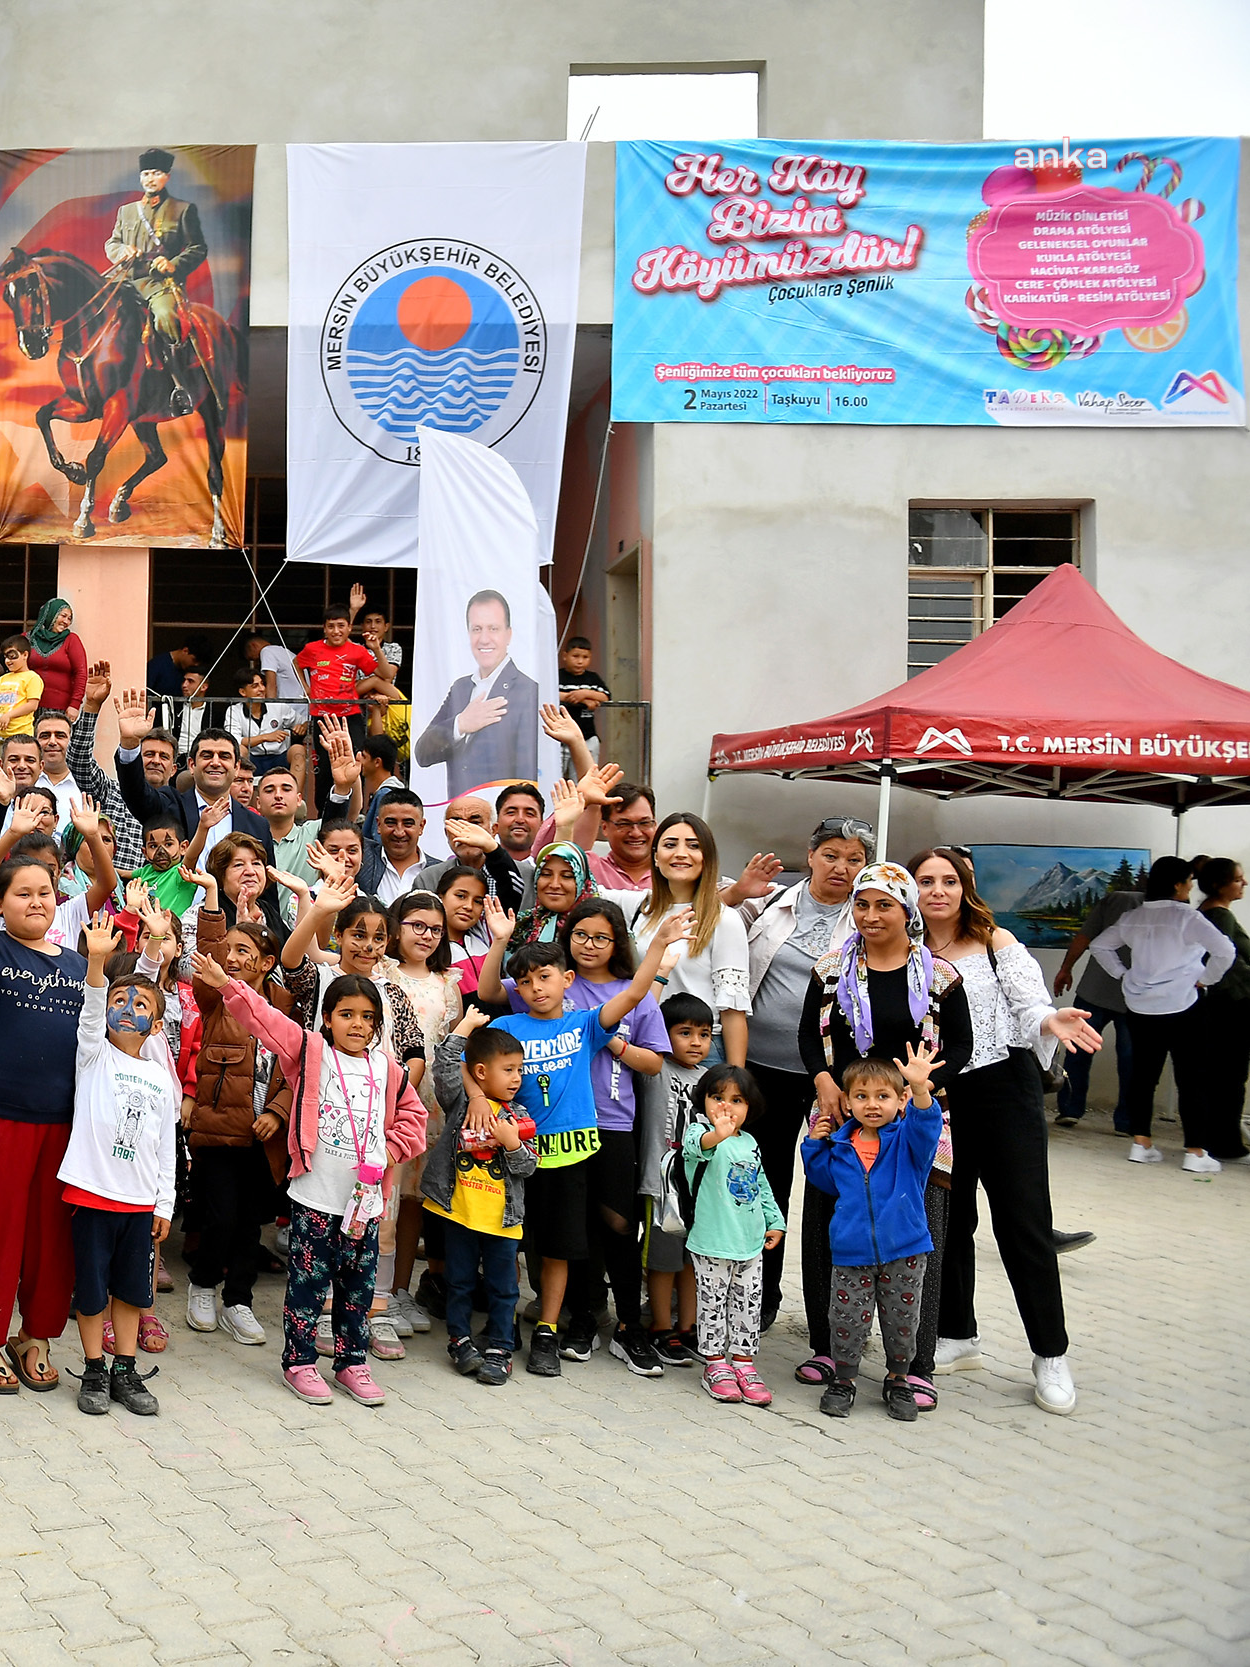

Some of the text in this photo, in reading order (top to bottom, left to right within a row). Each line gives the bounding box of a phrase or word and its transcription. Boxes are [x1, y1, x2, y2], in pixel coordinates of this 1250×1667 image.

[666, 153, 863, 206] Her Köy
[708, 198, 841, 239] Bizim
[1036, 210, 1071, 222] MÜZİK
[1033, 224, 1131, 236] DRAMA ATÖLYESİ
[1018, 237, 1148, 250] GELENEKSEL OYUNLAR
[633, 225, 922, 298] Köyümüzdür!
[1036, 250, 1131, 263] KUKLA ATÖLYESİ
[768, 275, 895, 305] Çocuklara Şenlik
[1015, 280, 1044, 290] CERE
[1052, 278, 1100, 291] ÇÖMLEK
[1102, 276, 1157, 288] ATÖLYESİ
[1004, 292, 1069, 304] KARİKATÜR
[1078, 291, 1114, 303] RESİM
[1115, 289, 1171, 302] ATÖLYESİ
[327, 246, 542, 375] MERSİN BÜYÜKŞEHİR BELEDİYESİ
[657, 366, 892, 384] Şenliğimize tüm çocukları bekliyoruz
[684, 389, 697, 410] 2
[701, 389, 758, 400] Mayıs 2022
[771, 394, 820, 407] Taşkuyu
[835, 396, 868, 407] 16.00
[701, 401, 747, 411] Pazartesi
[1077, 391, 1114, 414] Vahap
[405, 445, 420, 462] 18
[743, 742, 764, 762] MERSİN
[763, 736, 806, 759] BÜYÜKŞEHİR
[803, 730, 846, 753] BELEDİYESİ
[997, 735, 1037, 753] T.C.
[1042, 733, 1132, 755] MERSİN
[1, 988, 19, 997] YOU
[16, 1001, 54, 1013] GROWS
[520, 1027, 583, 1060] VENTURE
[542, 1057, 573, 1073] team
[459, 1178, 483, 1190] ONSTER
